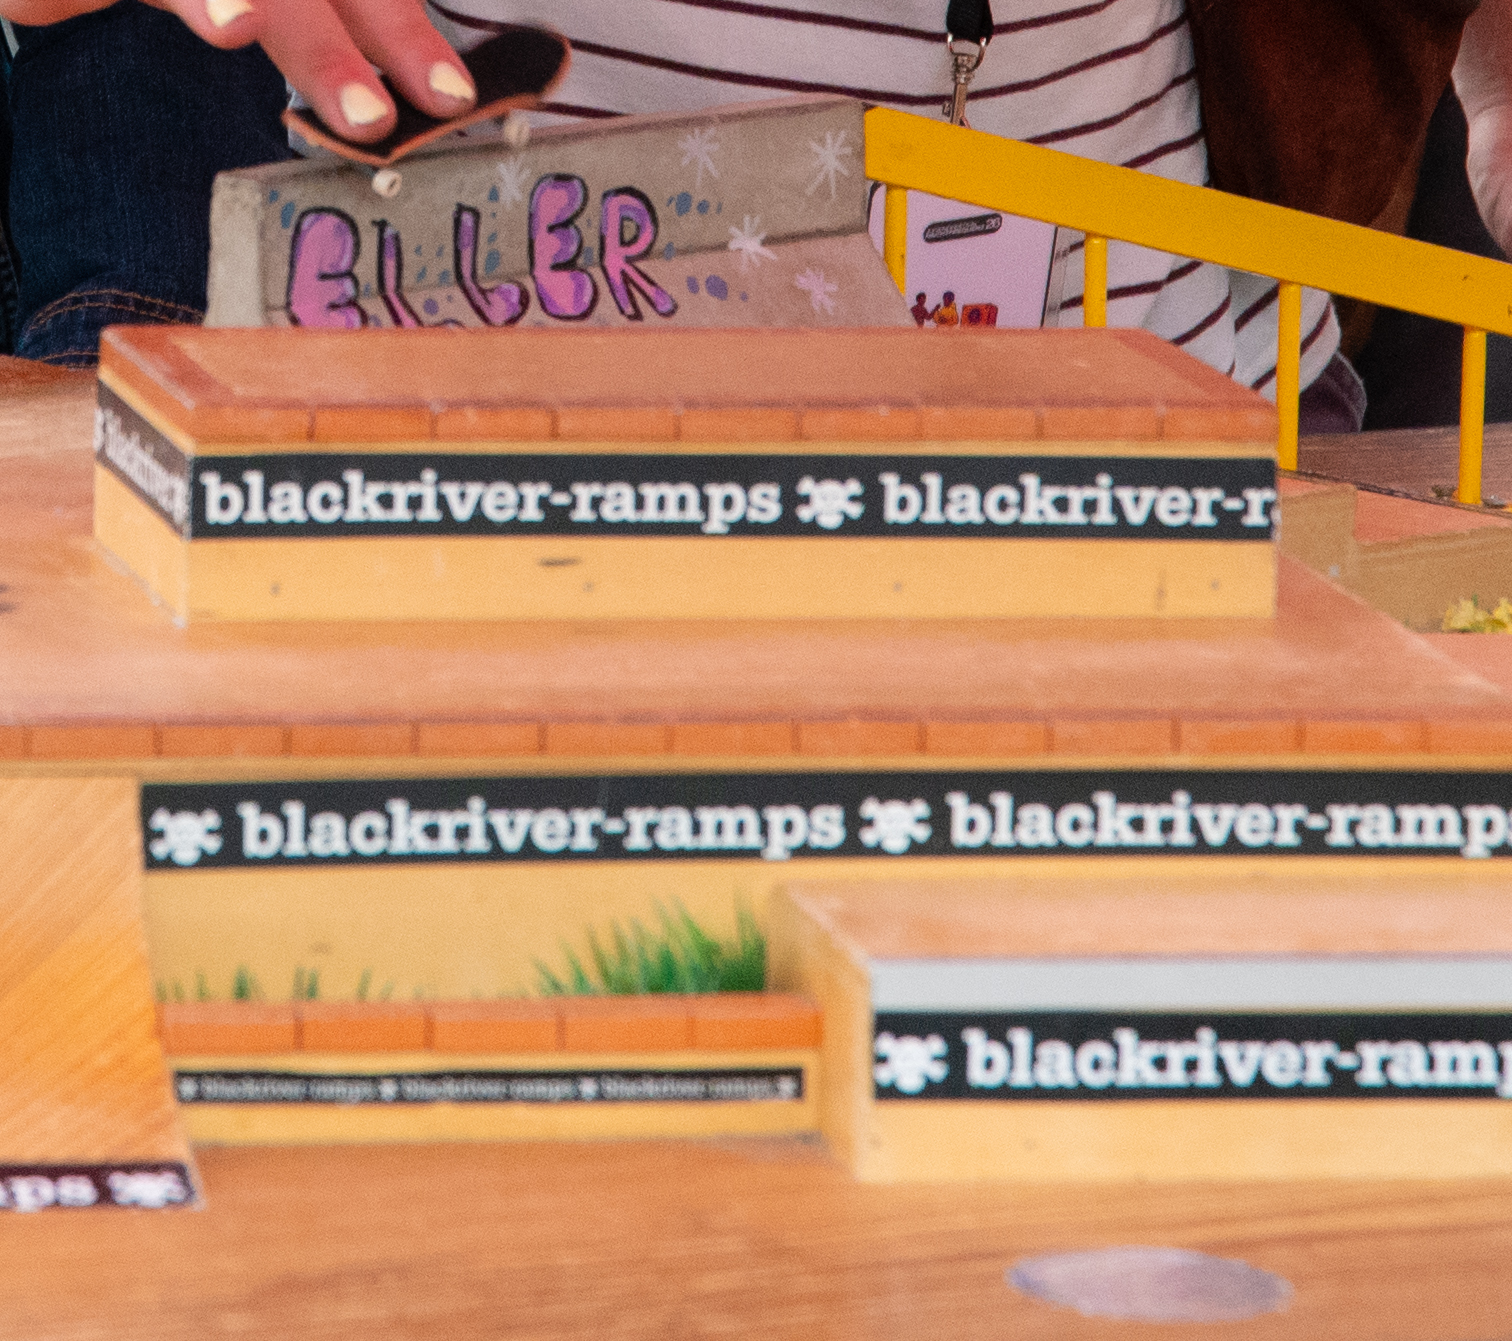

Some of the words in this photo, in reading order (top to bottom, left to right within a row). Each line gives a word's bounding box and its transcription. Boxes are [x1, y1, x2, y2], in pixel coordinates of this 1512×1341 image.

[202, 472, 780, 533] blackriver-ramps
[881, 472, 1280, 529] blackriver-r
[239, 797, 844, 860] blackriver-ramps
